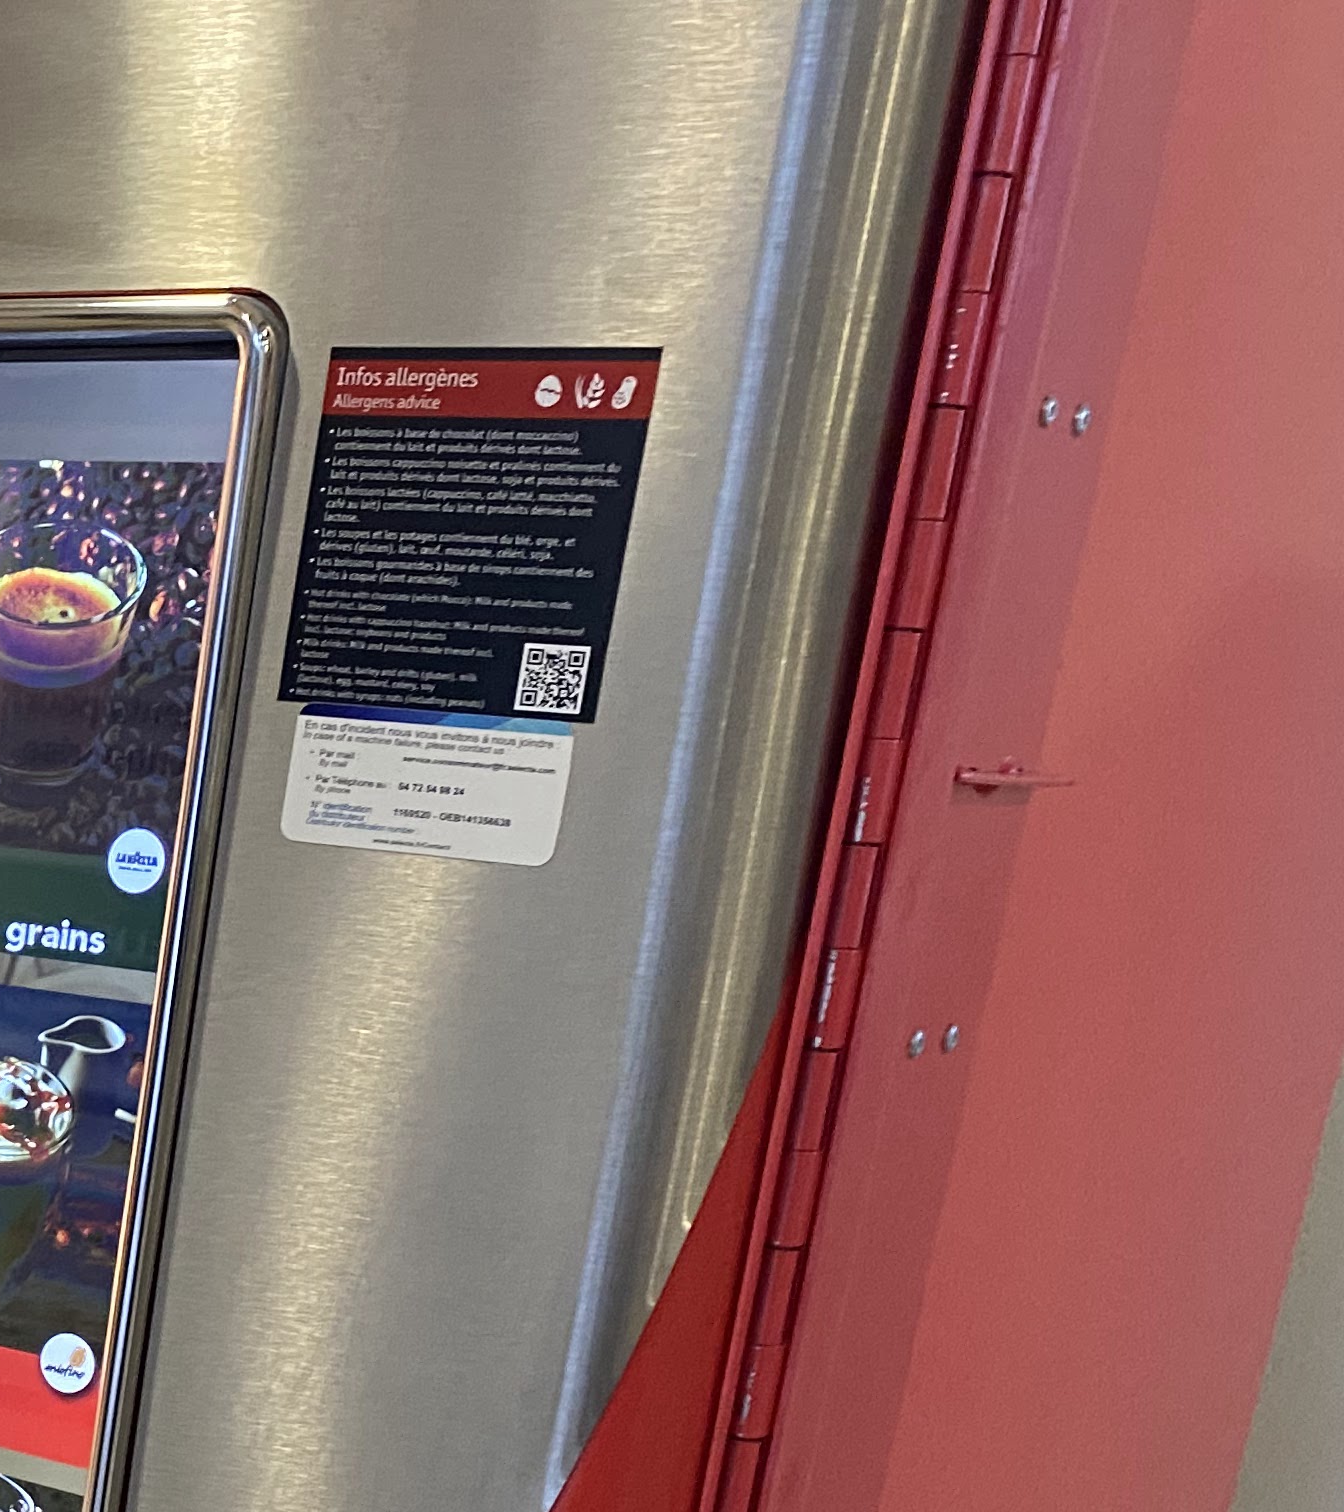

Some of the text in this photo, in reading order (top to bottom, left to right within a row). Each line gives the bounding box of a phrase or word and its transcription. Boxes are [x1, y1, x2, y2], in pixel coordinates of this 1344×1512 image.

[337, 367, 479, 391] Infos allergènes
[332, 394, 441, 413] Allergens advice
[6, 914, 108, 957] grains
